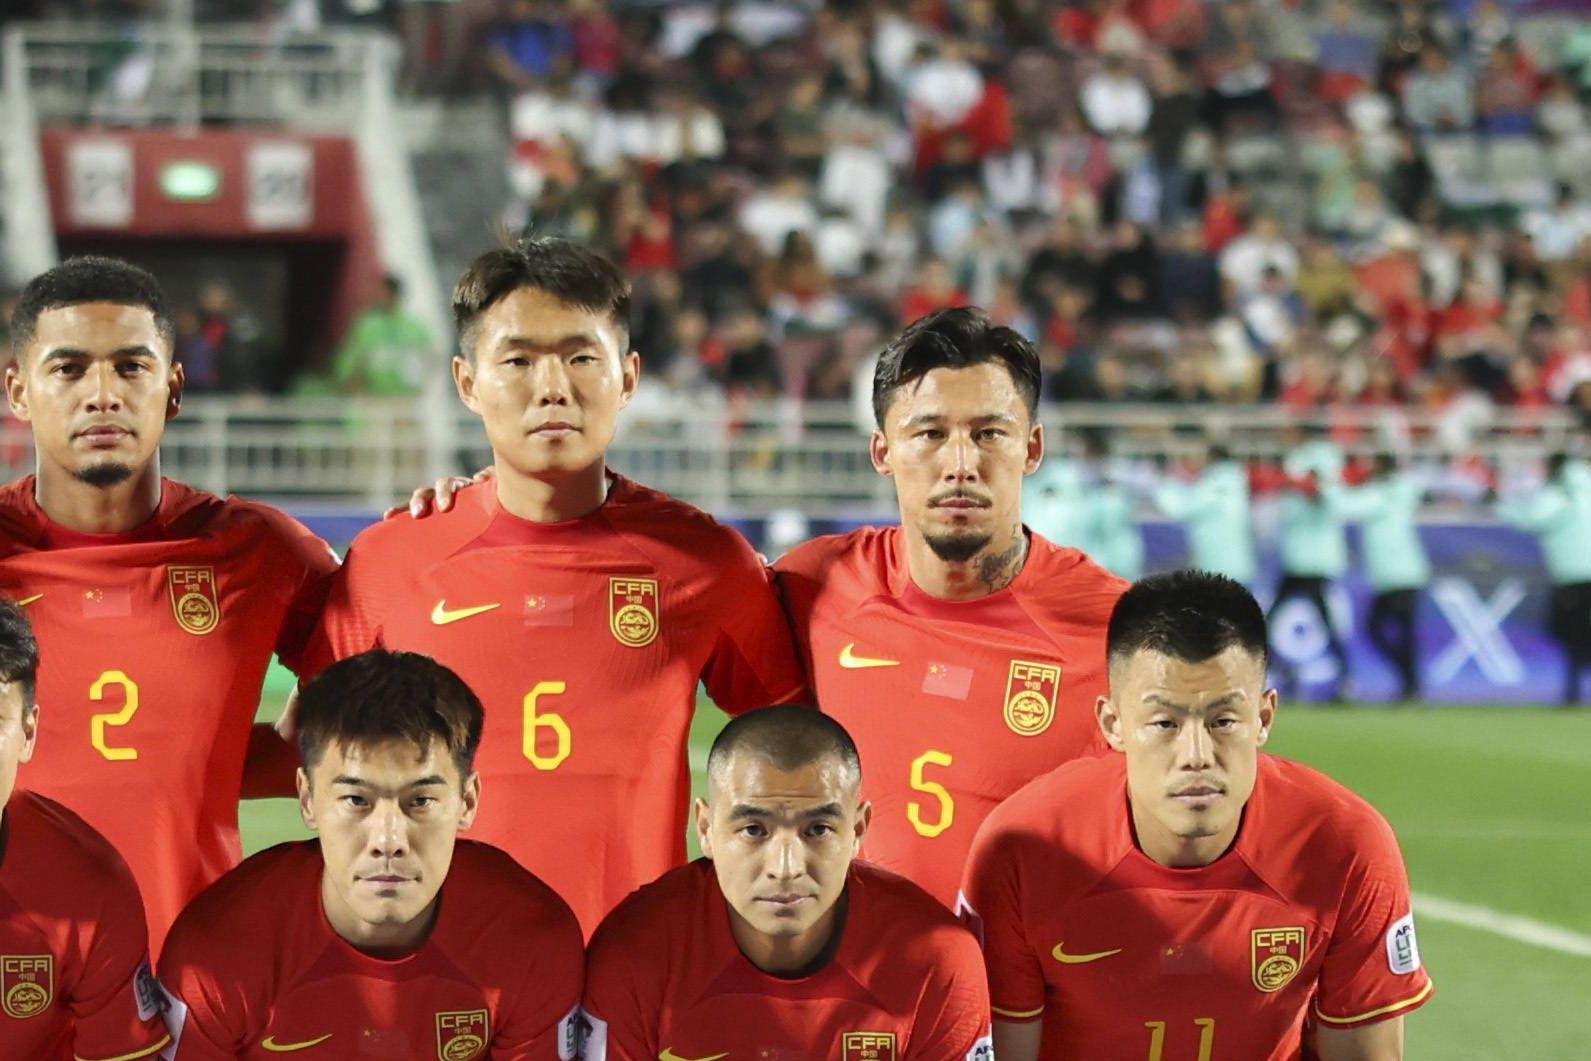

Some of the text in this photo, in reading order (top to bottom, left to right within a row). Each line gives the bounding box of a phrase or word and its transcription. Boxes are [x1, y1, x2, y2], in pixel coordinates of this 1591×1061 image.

[172, 570, 210, 584] CFA
[613, 582, 654, 596] CFA
[1013, 665, 1056, 684] CFA
[89, 670, 139, 761] 2
[522, 681, 571, 771] 6
[906, 750, 955, 838] 5
[1256, 931, 1300, 947] CFA
[5, 959, 48, 973] CFA
[441, 1014, 483, 1028] CFA
[847, 1037, 891, 1050] CFA
